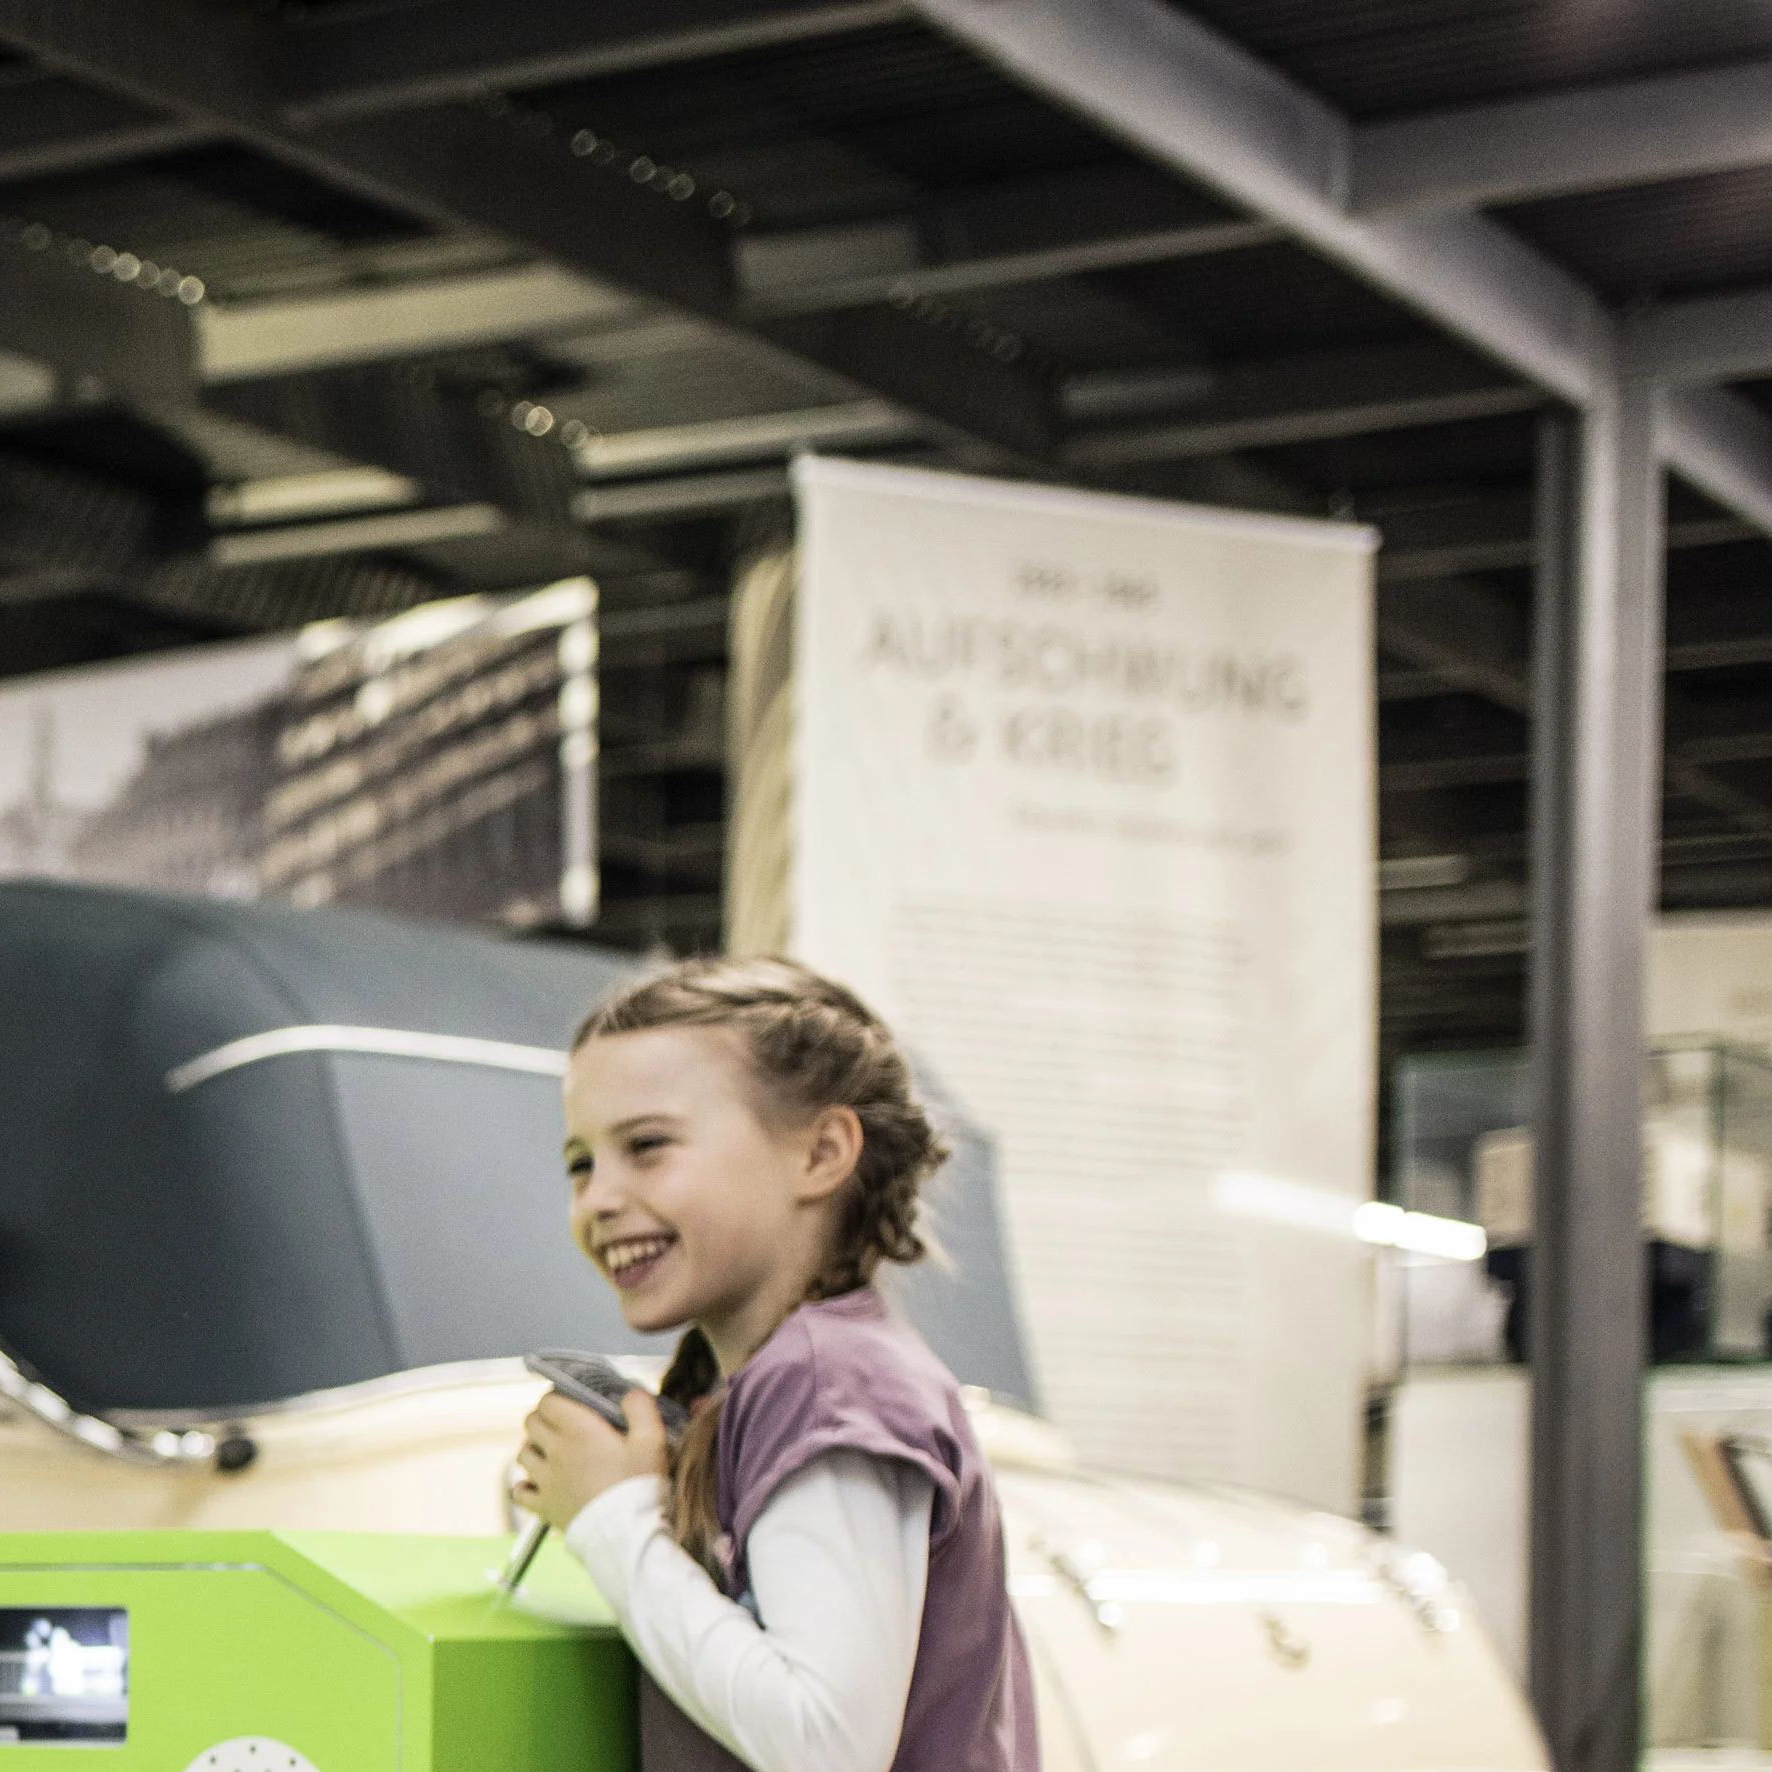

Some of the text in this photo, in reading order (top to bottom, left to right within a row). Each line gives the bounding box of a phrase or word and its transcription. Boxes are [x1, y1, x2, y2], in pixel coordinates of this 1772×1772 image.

[859, 608, 1308, 722] AUFSCHWUNG
[927, 695, 1176, 788] & KRIEG
